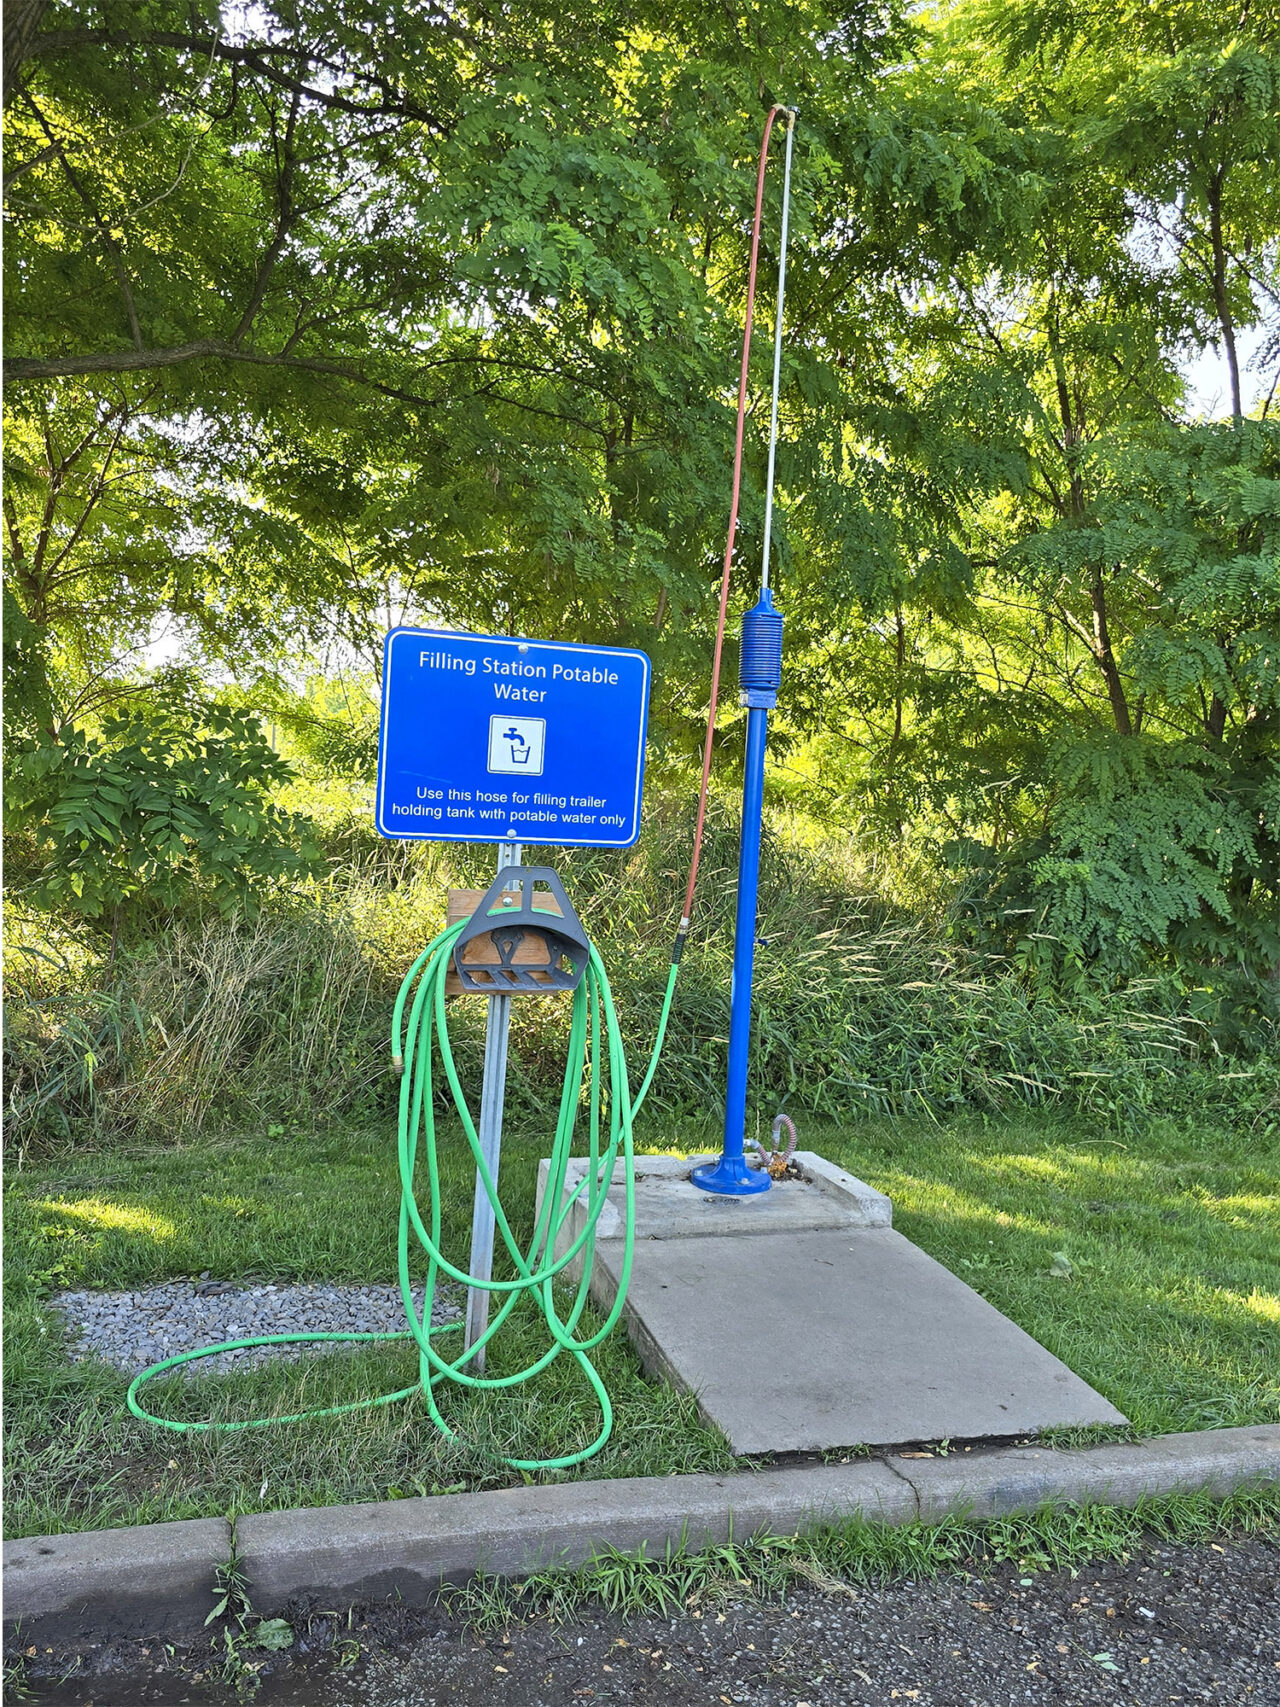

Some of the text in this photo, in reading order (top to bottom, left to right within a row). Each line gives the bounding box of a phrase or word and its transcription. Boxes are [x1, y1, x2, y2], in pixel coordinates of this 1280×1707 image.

[419, 651, 619, 685] Filling Station Potable
[493, 682, 547, 703] Water
[416, 786, 607, 809] Use this hose for filling trailer
[392, 802, 626, 828] holding tank with potable water only
